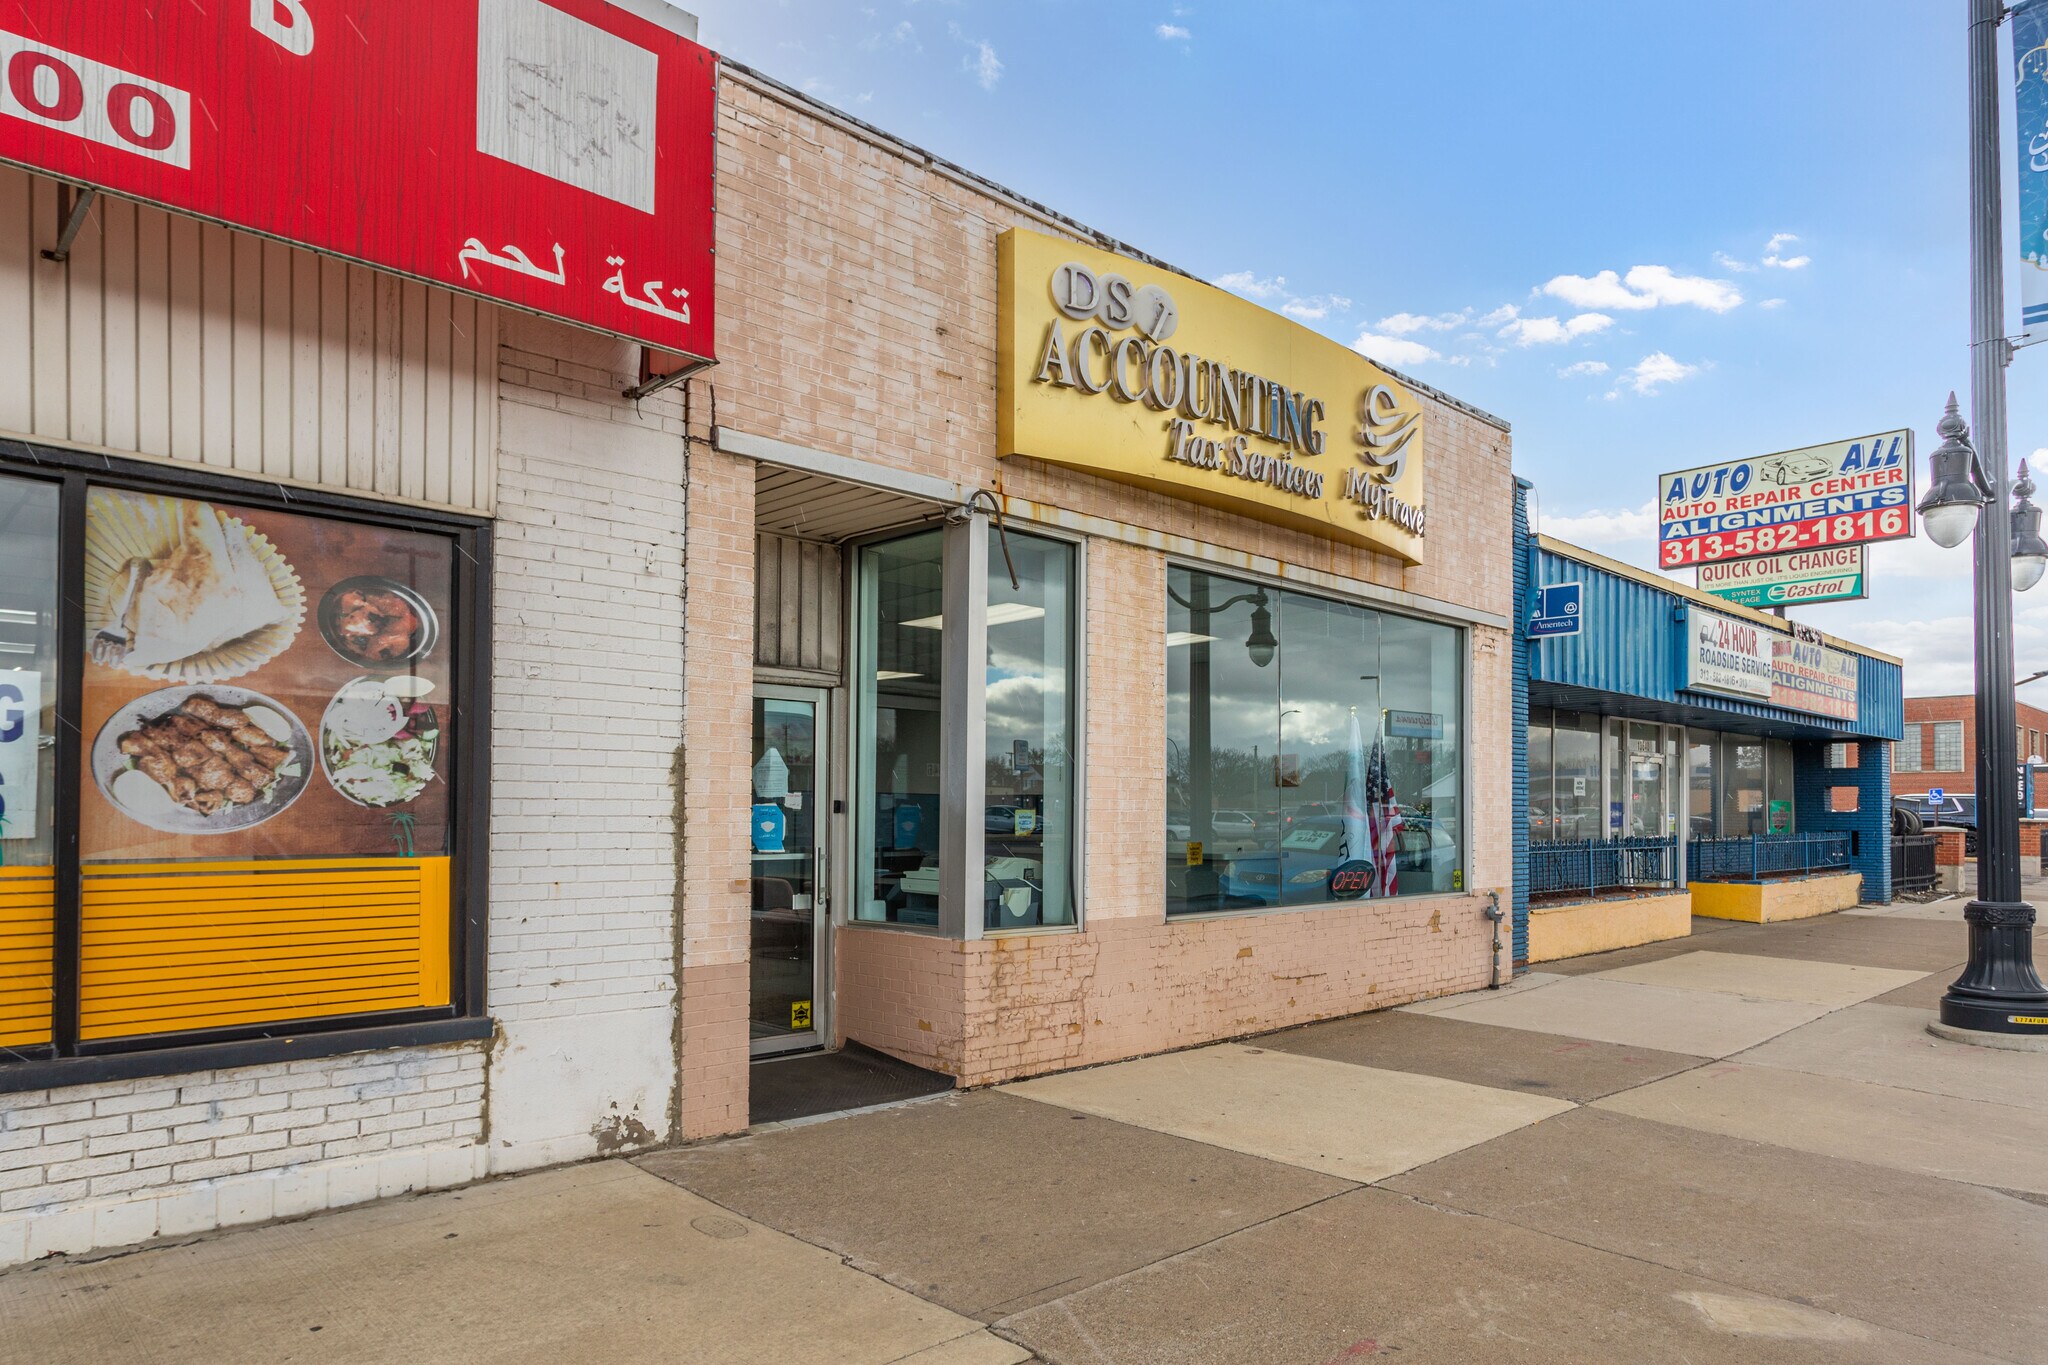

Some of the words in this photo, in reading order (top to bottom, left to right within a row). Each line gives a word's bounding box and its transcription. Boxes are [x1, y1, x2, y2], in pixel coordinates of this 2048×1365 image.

[458, 237, 565, 286] لحم
[602, 255, 690, 325] تكة
[1035, 317, 1328, 457] ACCOUNTING
[1168, 417, 1226, 470] Tax
[1227, 434, 1324, 499] Services
[1665, 463, 1753, 506] AUTO
[1839, 436, 1903, 475] ALL
[1345, 466, 1426, 538] MyTrave
[1663, 501, 1717, 521] AUTO
[1726, 486, 1801, 511] REPAIR
[1810, 468, 1904, 496] CENTER
[1666, 488, 1905, 538] ALIGNMENTS
[1665, 508, 1902, 564] 313-582-1816
[1702, 561, 1751, 582] QUICK
[1757, 558, 1783, 575] OIL
[1788, 548, 1857, 571] CHANGE
[1731, 589, 1761, 598] SYNTEX
[1787, 580, 1843, 598] Castrol
[1718, 619, 1730, 650] 24
[1732, 623, 1758, 657] HOUR
[1699, 647, 1740, 672] ROADSIDE
[1741, 657, 1771, 679] SERVICE
[1772, 659, 1795, 674] AUTO
[1798, 665, 1826, 683] REPAIR
[1827, 674, 1856, 691] CENTER
[1793, 642, 1822, 669] AUTO
[1840, 657, 1855, 679] ALL
[1772, 671, 1856, 702] ALIGNMENTS
[1332, 871, 1373, 891] OPEN
